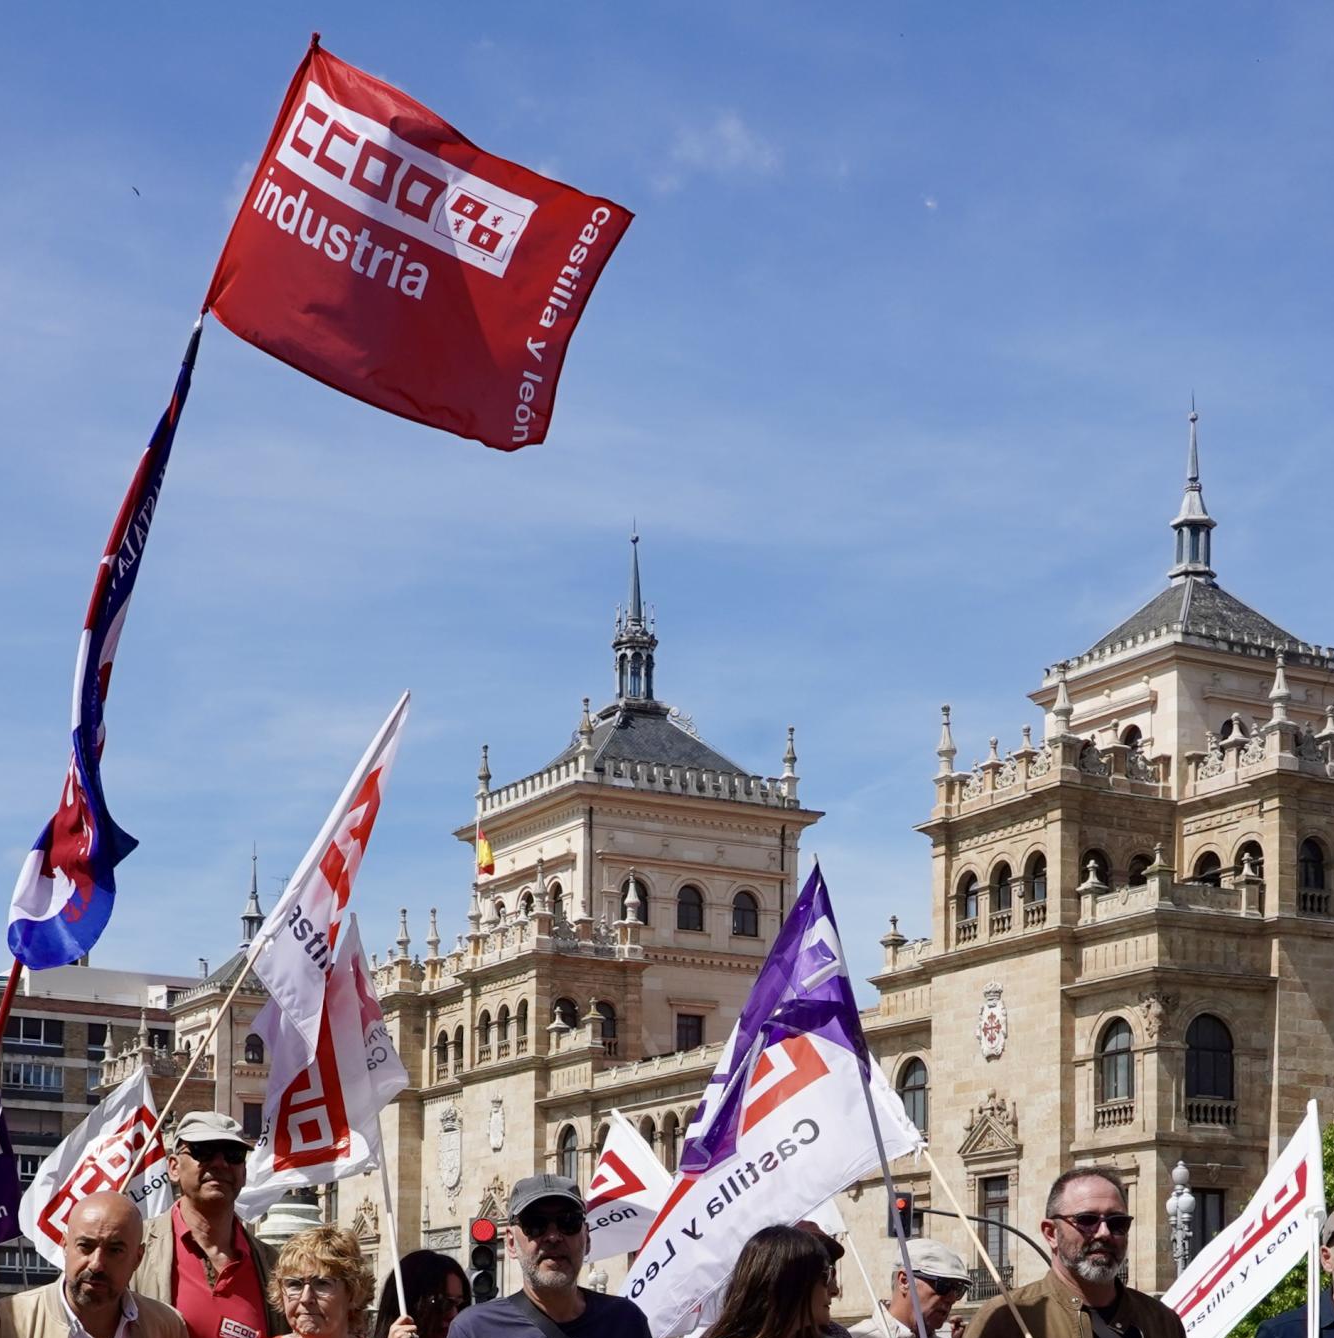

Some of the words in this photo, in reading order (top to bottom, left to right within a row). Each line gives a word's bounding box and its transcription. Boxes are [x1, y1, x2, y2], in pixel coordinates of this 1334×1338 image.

[290, 102, 448, 223] CCOO
[253, 168, 429, 300] industria
[538, 206, 611, 328] castilla
[512, 369, 544, 443] león
[526, 336, 547, 362] y
[1186, 1280, 1235, 1333] astilla
[1255, 1219, 1299, 1266] León
